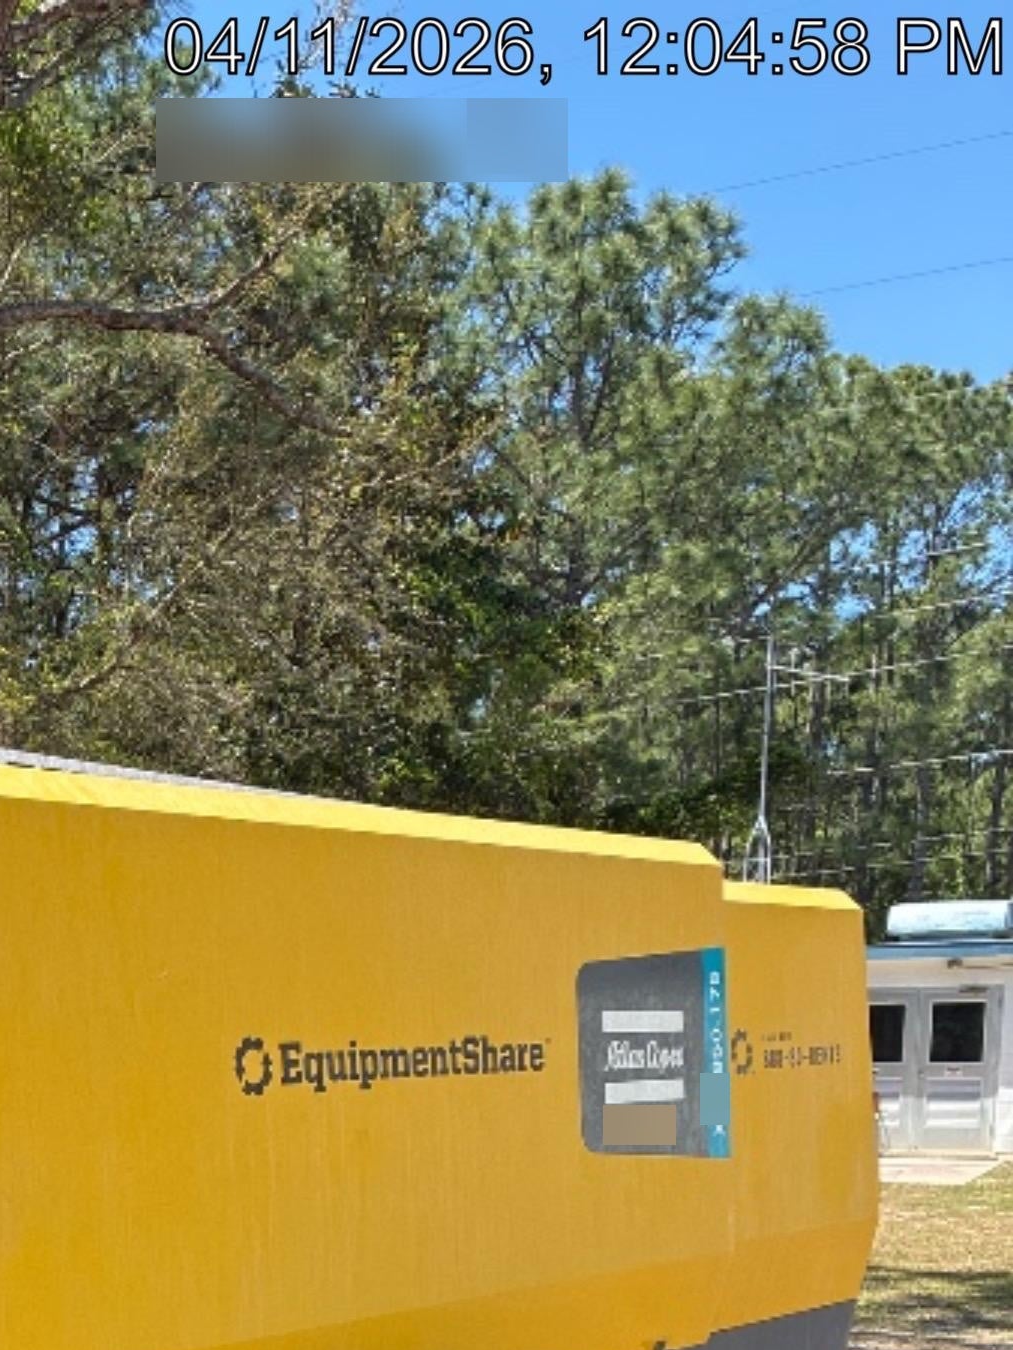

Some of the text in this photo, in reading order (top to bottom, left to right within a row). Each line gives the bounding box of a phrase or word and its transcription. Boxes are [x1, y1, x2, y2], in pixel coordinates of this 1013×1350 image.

[278, 1036, 545, 1093] EquipmentShare
[604, 1040, 685, 1074] Atlas Copco
